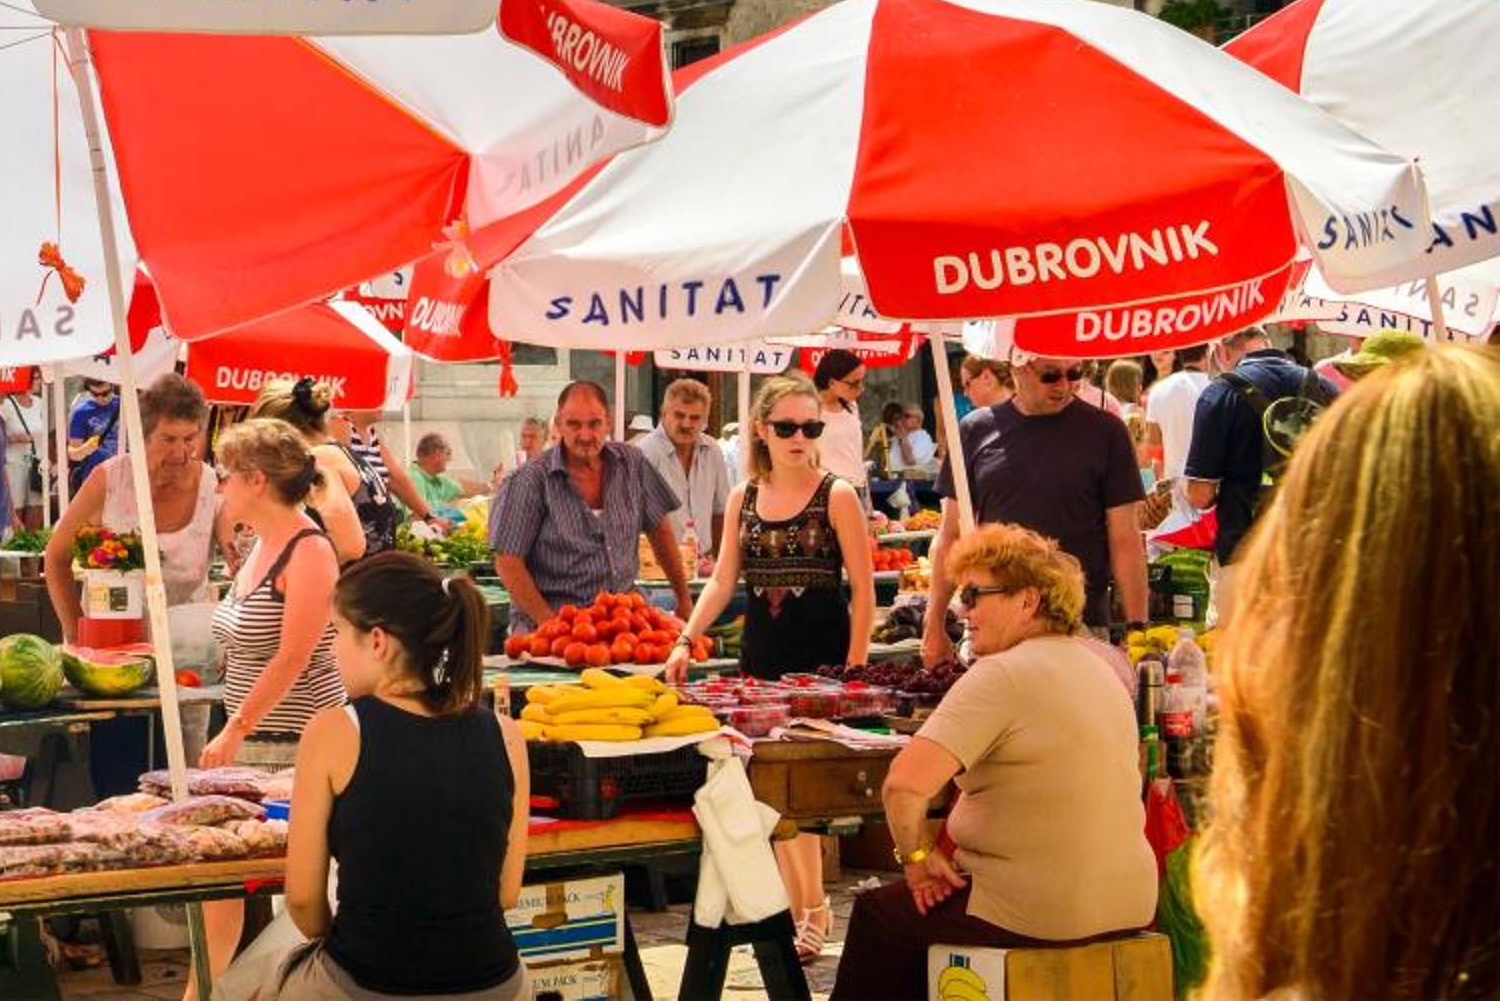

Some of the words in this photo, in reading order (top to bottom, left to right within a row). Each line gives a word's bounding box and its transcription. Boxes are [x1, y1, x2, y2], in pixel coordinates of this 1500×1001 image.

[933, 220, 1218, 294] DUBROVNIK
[546, 274, 781, 326] SANITAT
[1075, 278, 1265, 341] DUBROVNIK
